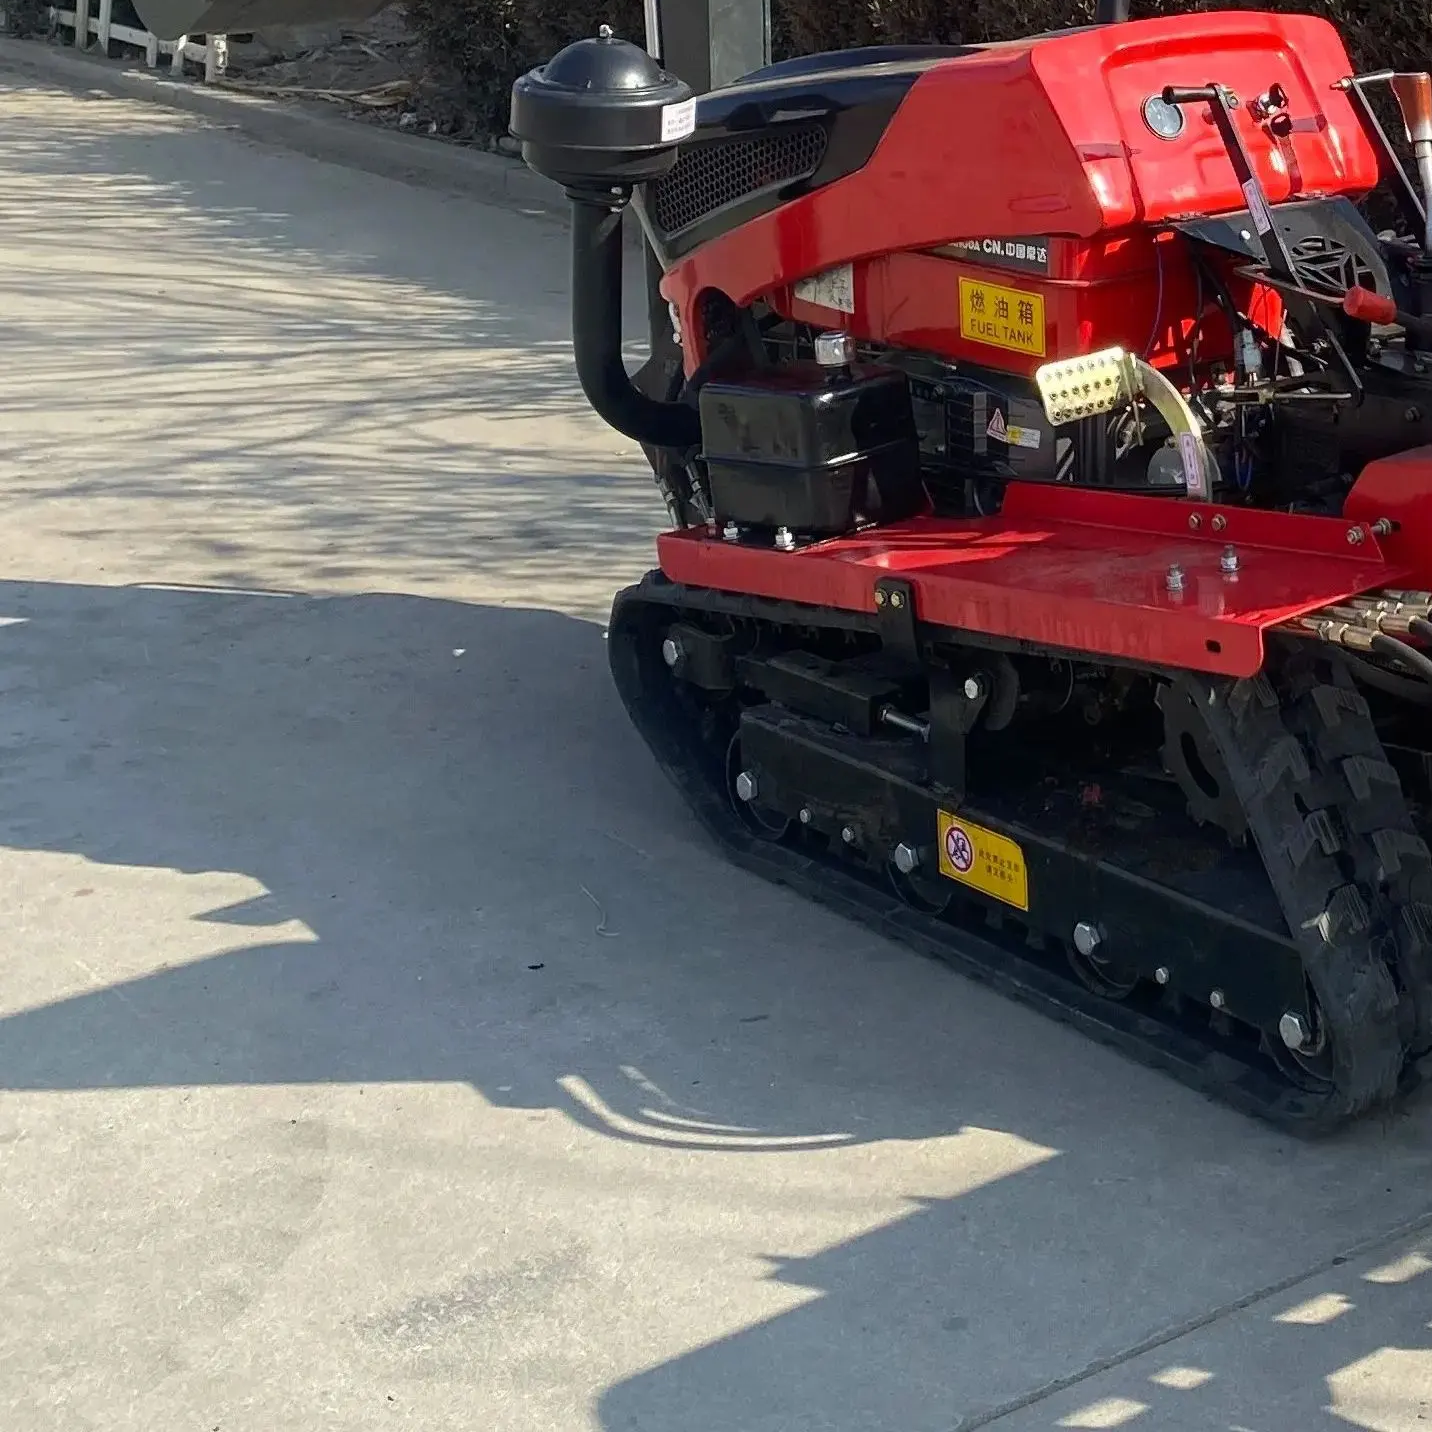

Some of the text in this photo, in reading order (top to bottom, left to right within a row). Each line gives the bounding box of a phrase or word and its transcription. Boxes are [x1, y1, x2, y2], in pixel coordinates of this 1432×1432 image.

[970, 288, 1034, 326] 燃油箱
[970, 318, 1034, 346] FUEL TANK
